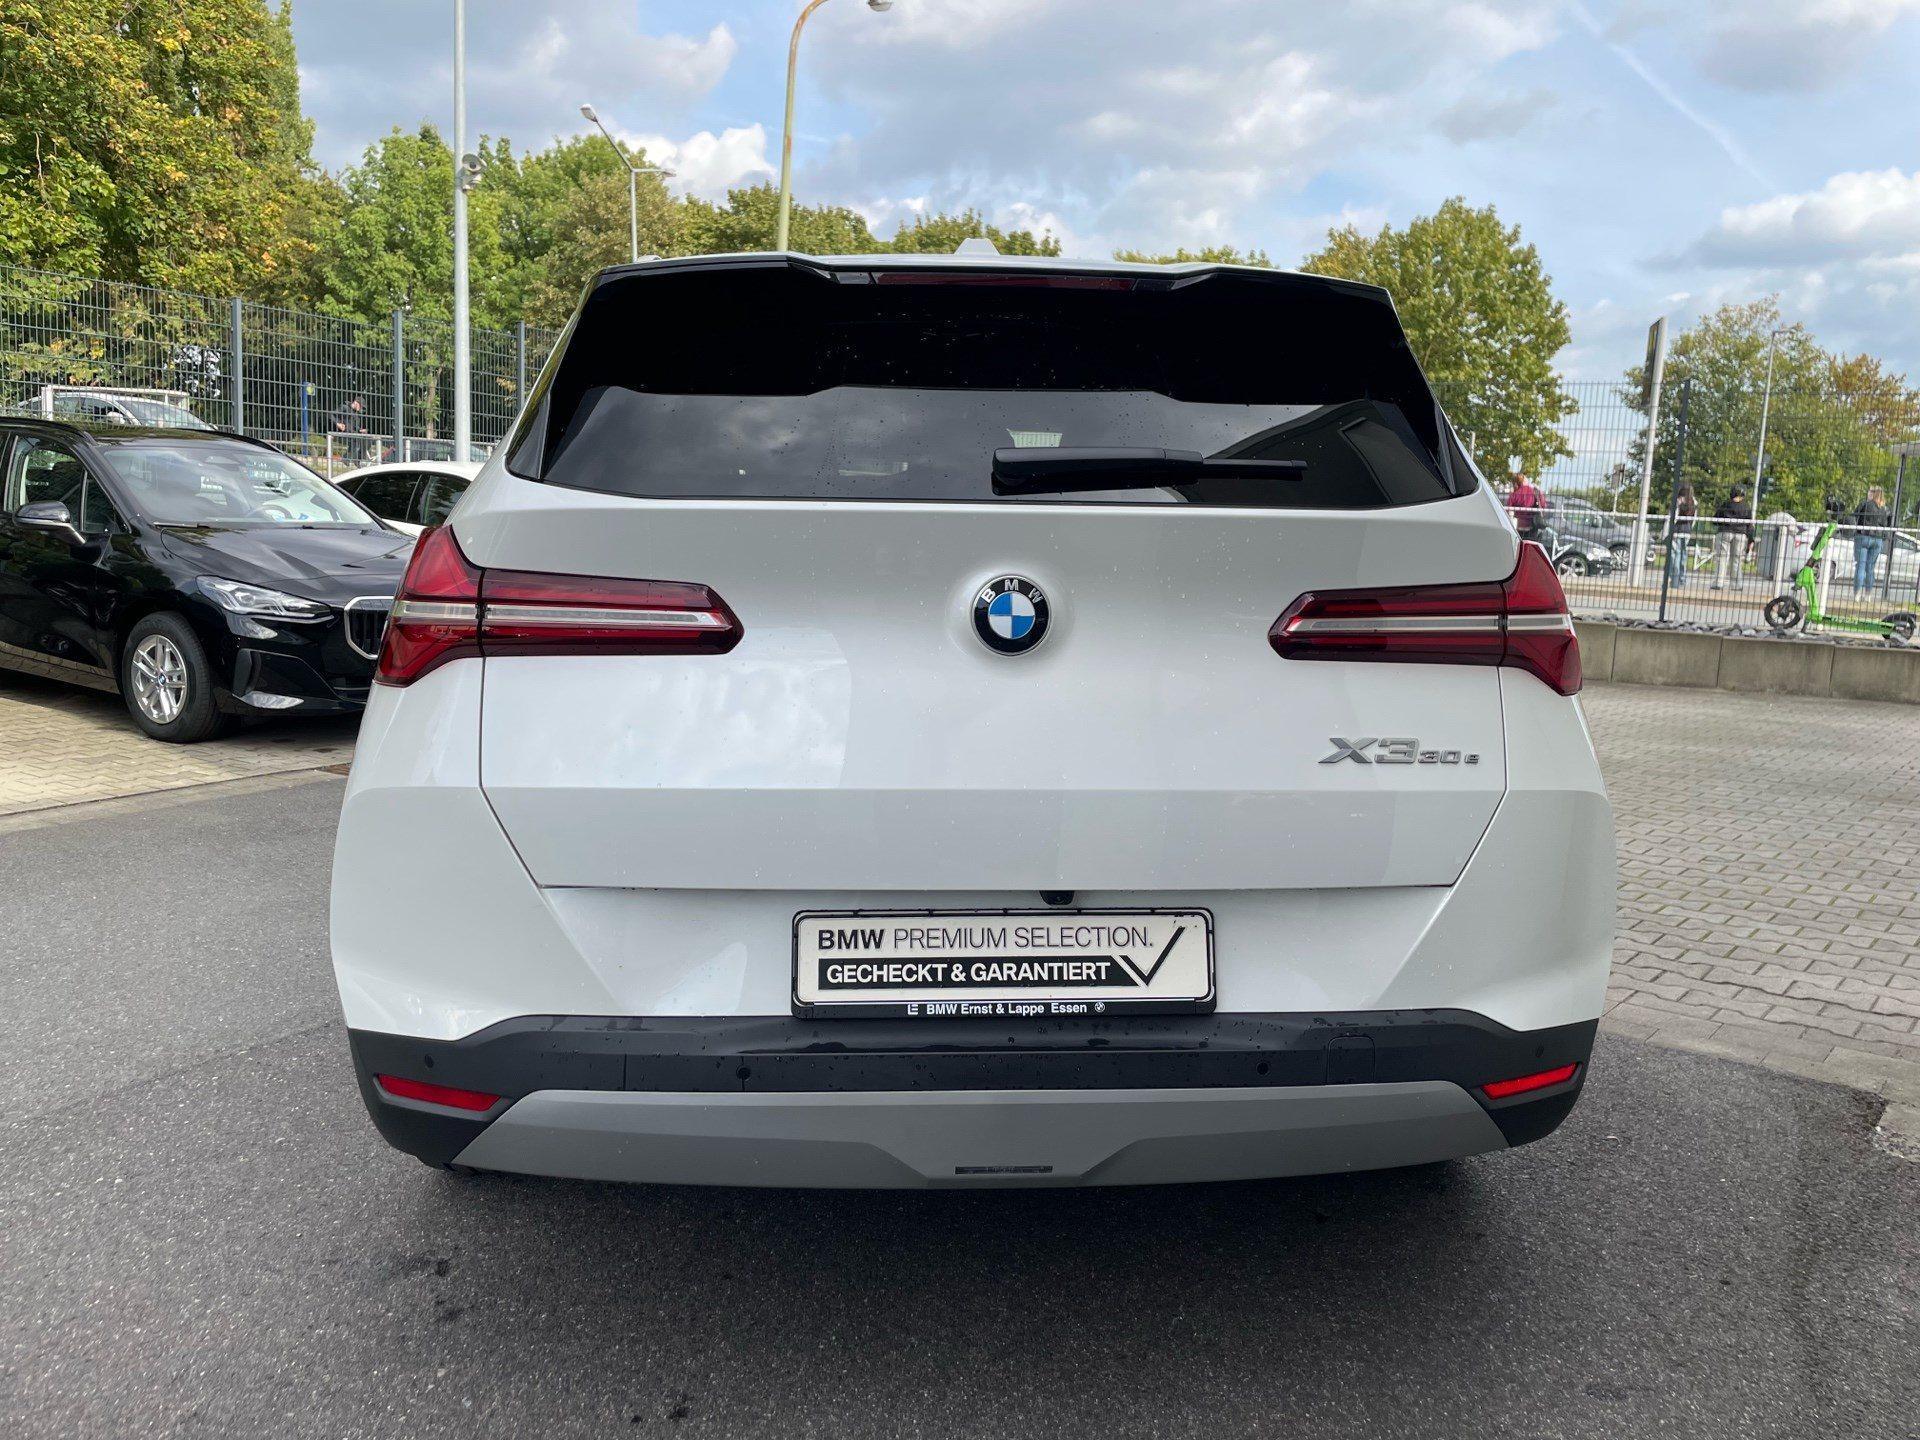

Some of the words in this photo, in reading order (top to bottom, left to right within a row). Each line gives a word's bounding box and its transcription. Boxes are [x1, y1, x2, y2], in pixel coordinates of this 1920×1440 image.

[981, 579, 1044, 604] BMW
[818, 928, 885, 950] BMW
[893, 927, 1007, 949] PREMIUM
[1014, 925, 1154, 948] SELECTION.
[826, 962, 948, 983] GECHECKT
[950, 962, 967, 983] &
[970, 960, 1111, 982] GARANTIERT
[926, 1003, 958, 1015] BMW
[961, 1003, 993, 1015] Ernst
[995, 1003, 1005, 1014] &
[1008, 1003, 1045, 1017] Lappe
[1051, 1002, 1088, 1013] Essen
